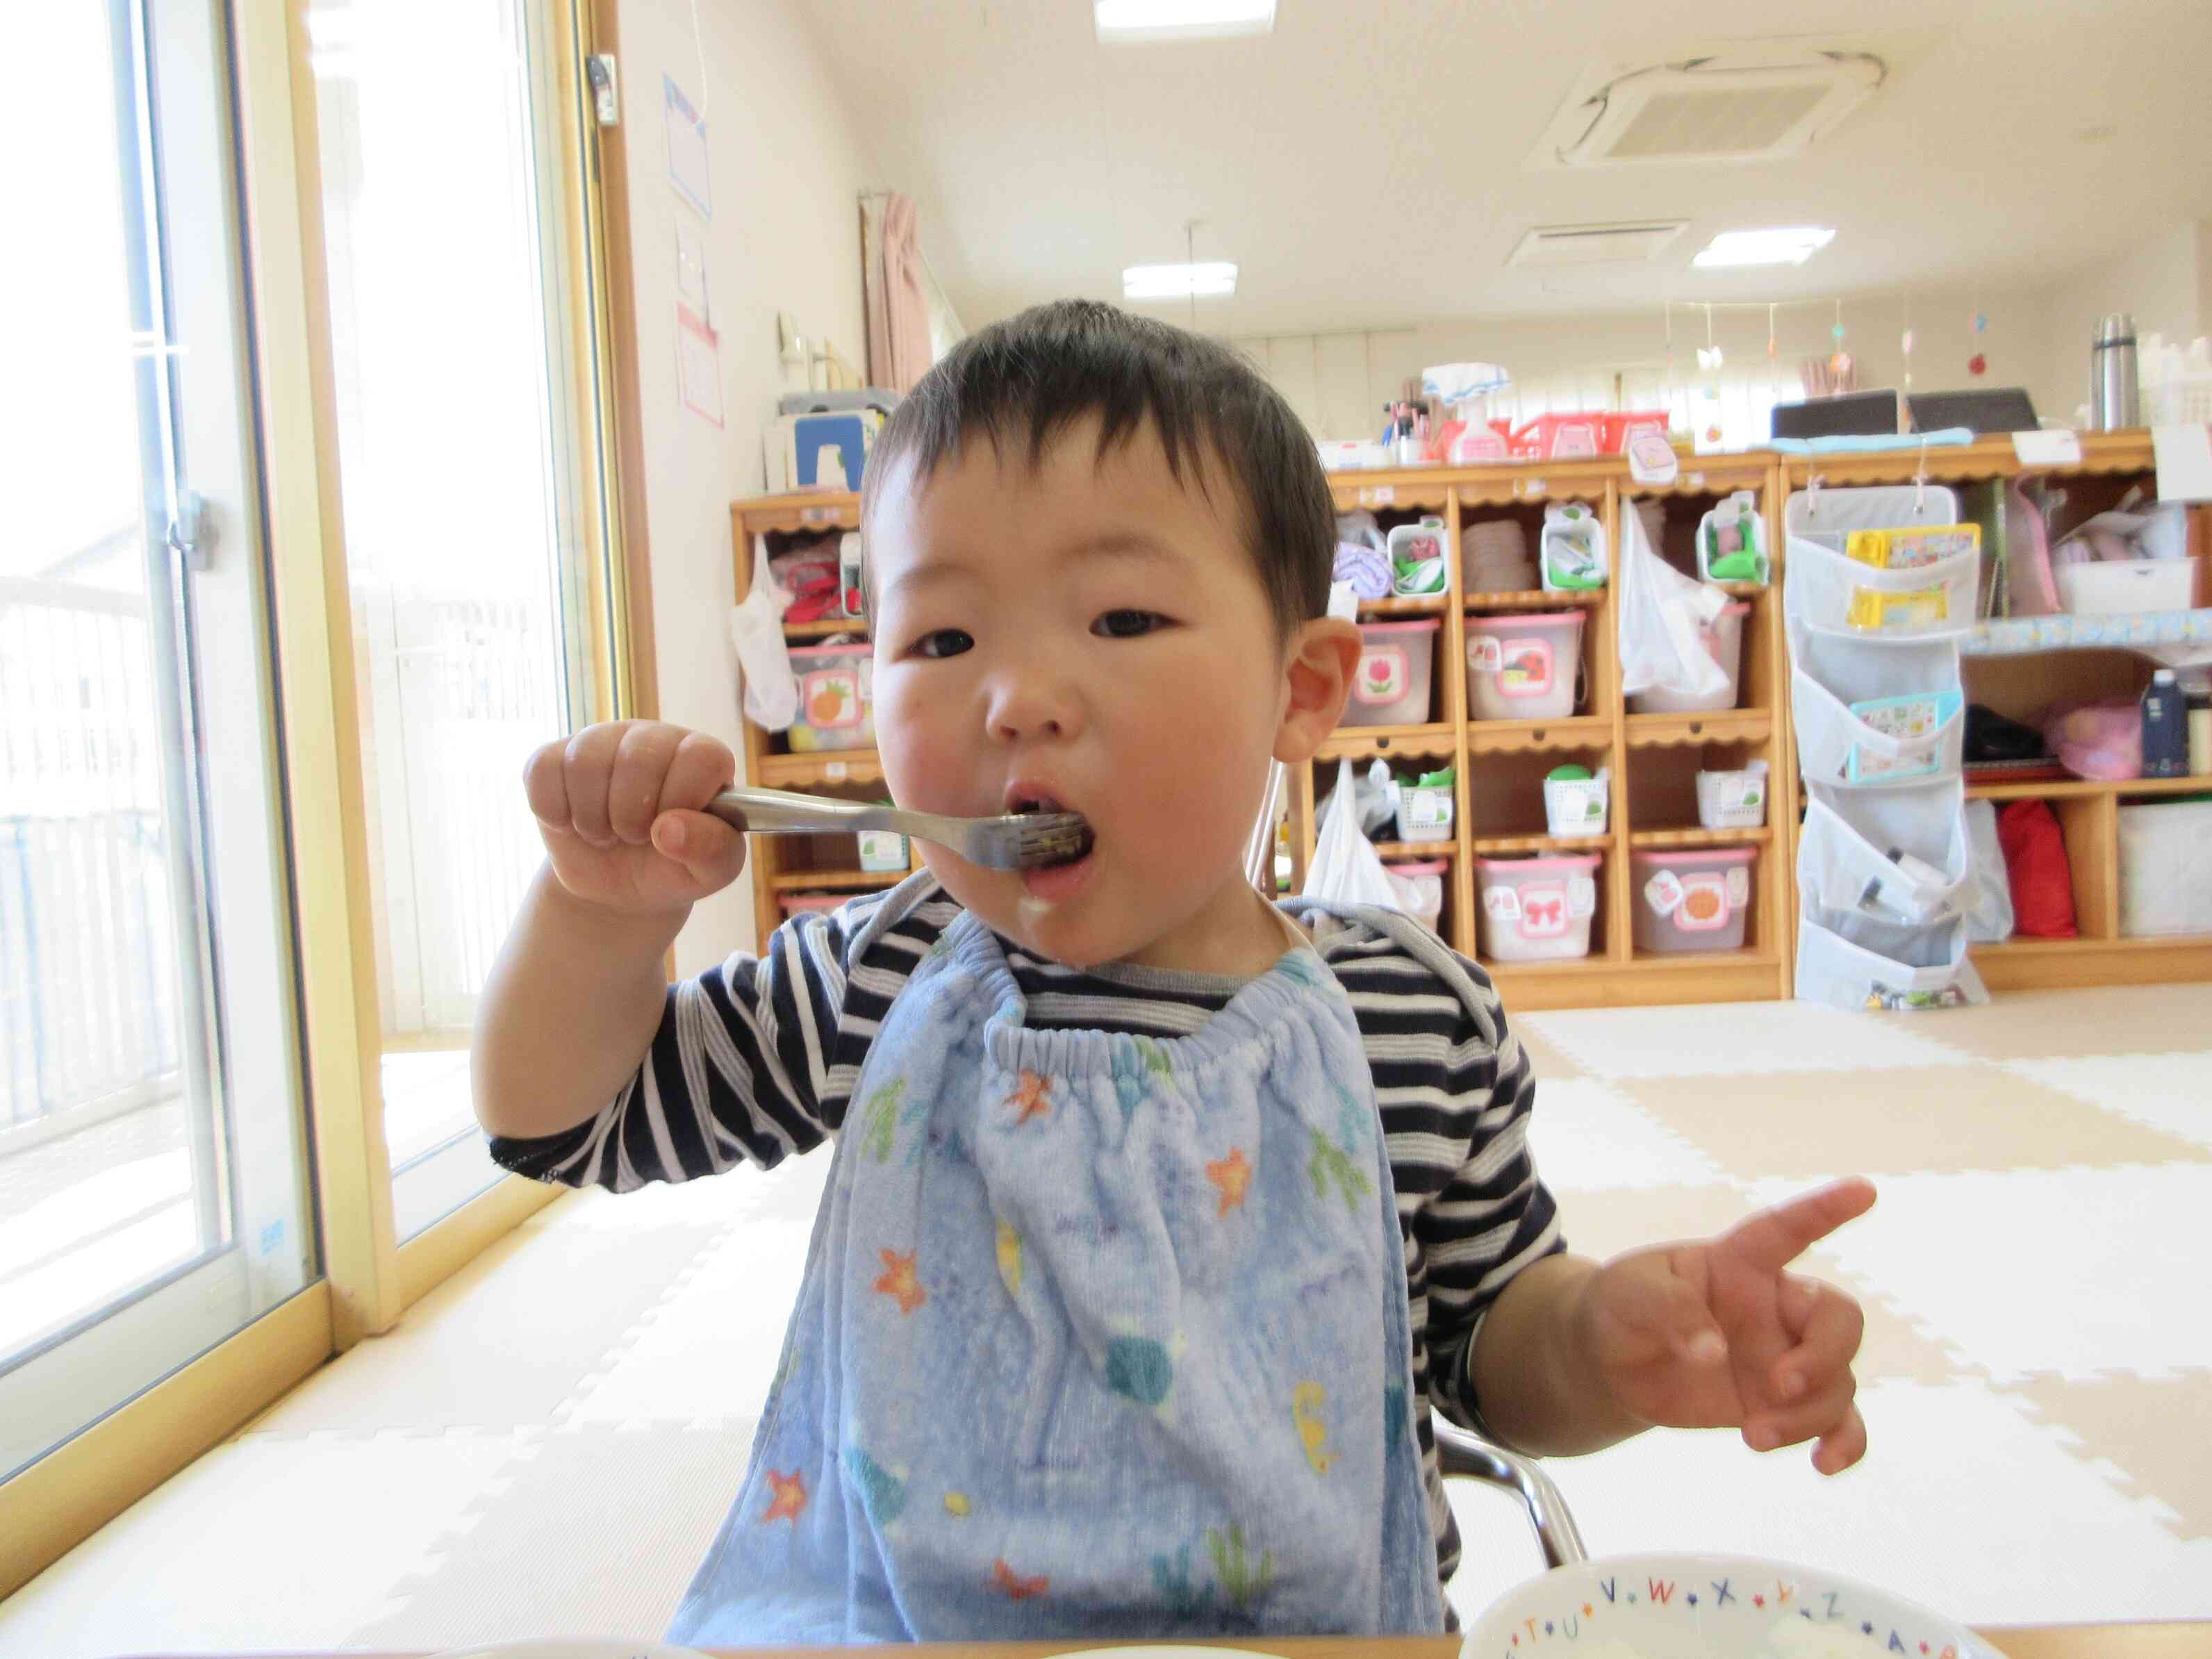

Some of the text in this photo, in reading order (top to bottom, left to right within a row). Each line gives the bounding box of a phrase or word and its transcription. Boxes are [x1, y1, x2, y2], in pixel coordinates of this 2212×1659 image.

[1562, 1612, 1578, 1640] U
[1601, 1576, 1615, 1603] V
[1647, 1576, 1675, 1604] W
[1710, 1577, 1735, 1606] X
[1820, 1592, 1843, 1618] Z
[1888, 1628, 1905, 1653] A
